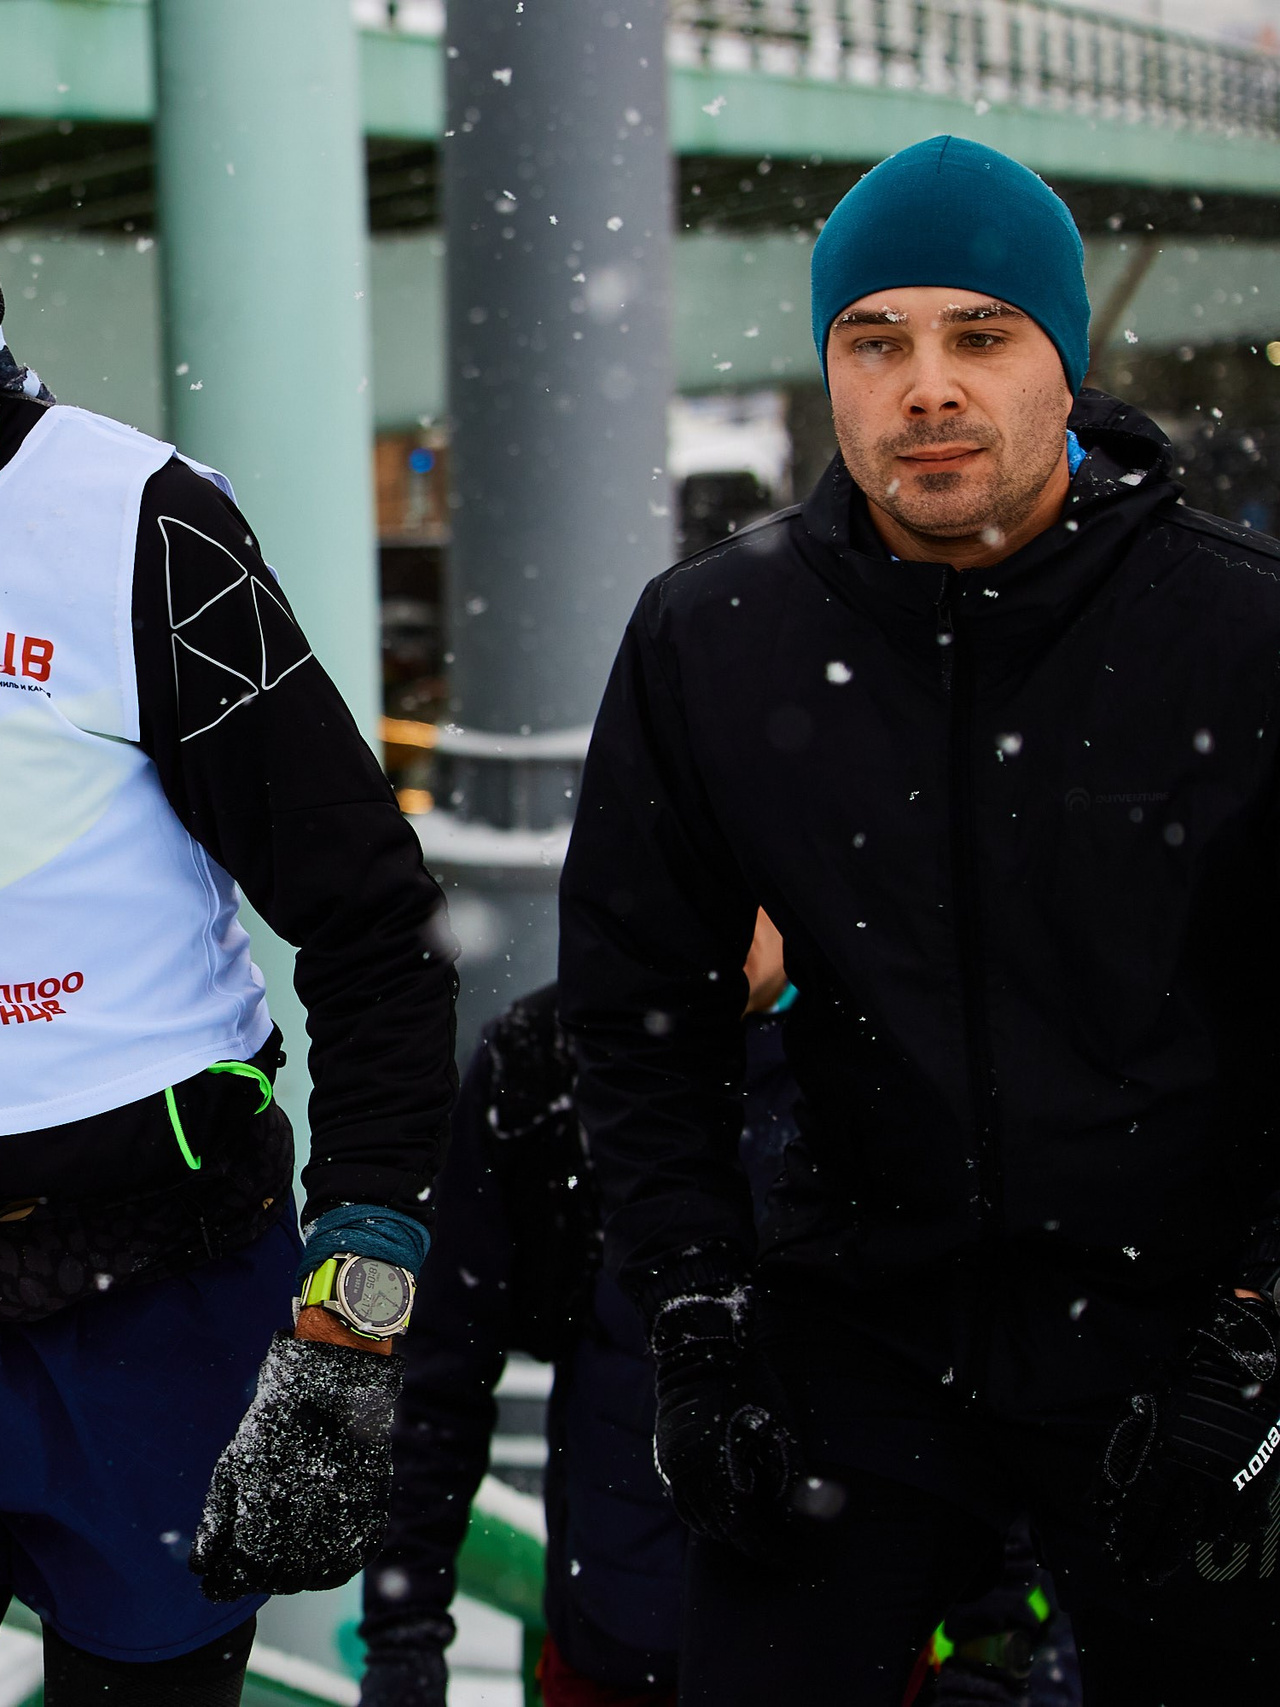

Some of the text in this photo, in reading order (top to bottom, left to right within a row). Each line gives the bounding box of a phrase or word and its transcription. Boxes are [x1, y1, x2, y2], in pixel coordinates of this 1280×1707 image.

[20, 683, 27, 691] И
[365, 1263, 378, 1289] 18:05
[1231, 1413, 1280, 1493] nona
